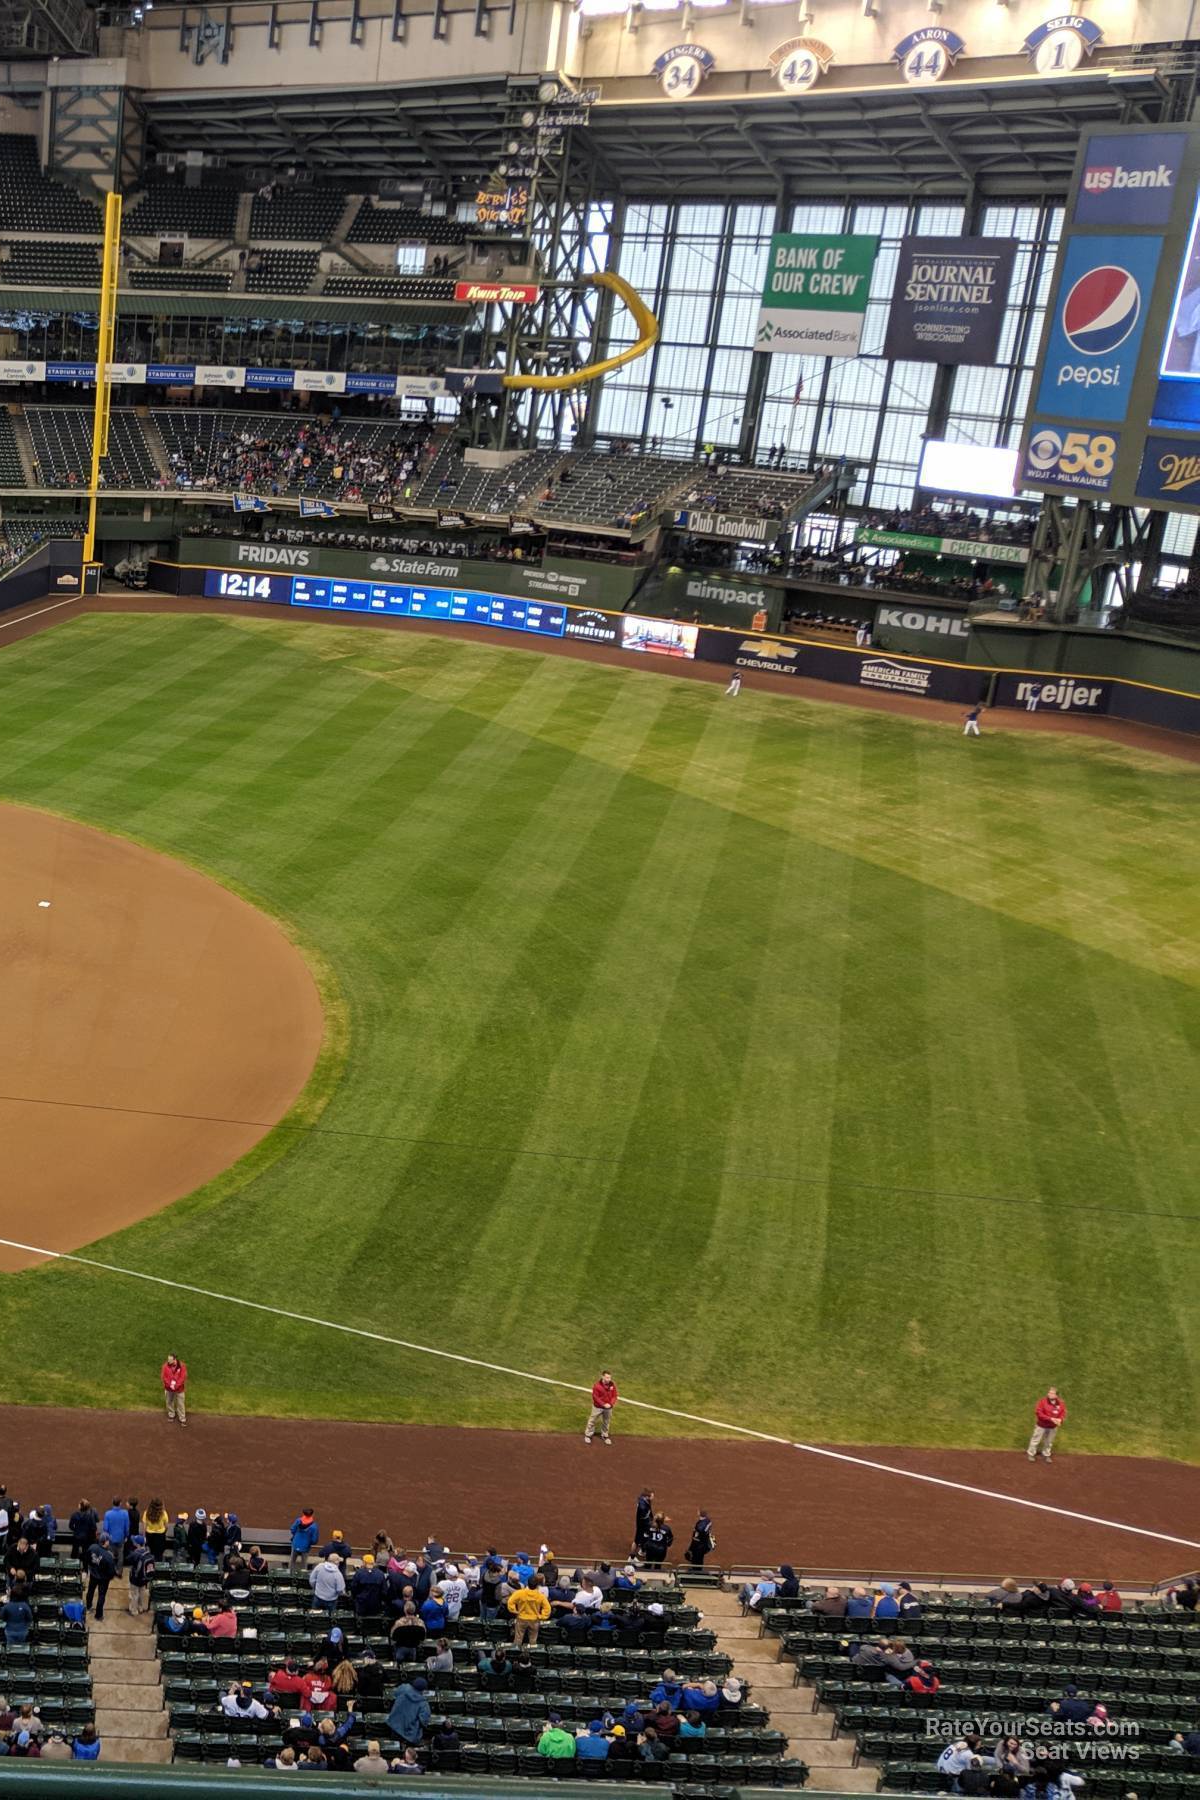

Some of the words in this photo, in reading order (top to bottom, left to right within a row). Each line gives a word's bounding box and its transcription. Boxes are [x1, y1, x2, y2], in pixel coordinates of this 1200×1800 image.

[1046, 16, 1084, 30] SELIG
[912, 30, 948, 42] AARON
[664, 43, 707, 62] FINGERS
[908, 51, 942, 75] 44
[1052, 42, 1066, 69] 1
[667, 65, 695, 88] 34
[783, 61, 813, 84] 42
[775, 248, 818, 269] BANK
[822, 249, 846, 270] OF
[771, 272, 806, 293] OUR
[808, 274, 859, 296] CREW
[908, 264, 997, 285] JOURNAL
[467, 286, 499, 299] KWIK
[499, 287, 527, 300] TRIP
[904, 283, 993, 304] SENTINEL
[913, 304, 980, 314] jsonline.com
[1057, 365, 1120, 388] pepsi
[1059, 432, 1117, 477] 58
[1027, 469, 1050, 480] WDJT
[1056, 472, 1110, 488] MILWAUKEE
[688, 512, 714, 531] Club
[716, 517, 767, 540] Goodwill
[238, 545, 311, 567] FRIDAYS
[950, 541, 988, 557] CHECK
[990, 545, 1022, 560] DECK
[220, 573, 271, 599] 12:14
[701, 580, 766, 606] impact
[736, 657, 798, 674] CHEVROLET
[862, 664, 901, 676] AMERICAN
[902, 671, 929, 680] FAMILY
[1016, 679, 1102, 710] meijer
[652, 1532, 663, 1541] 19
